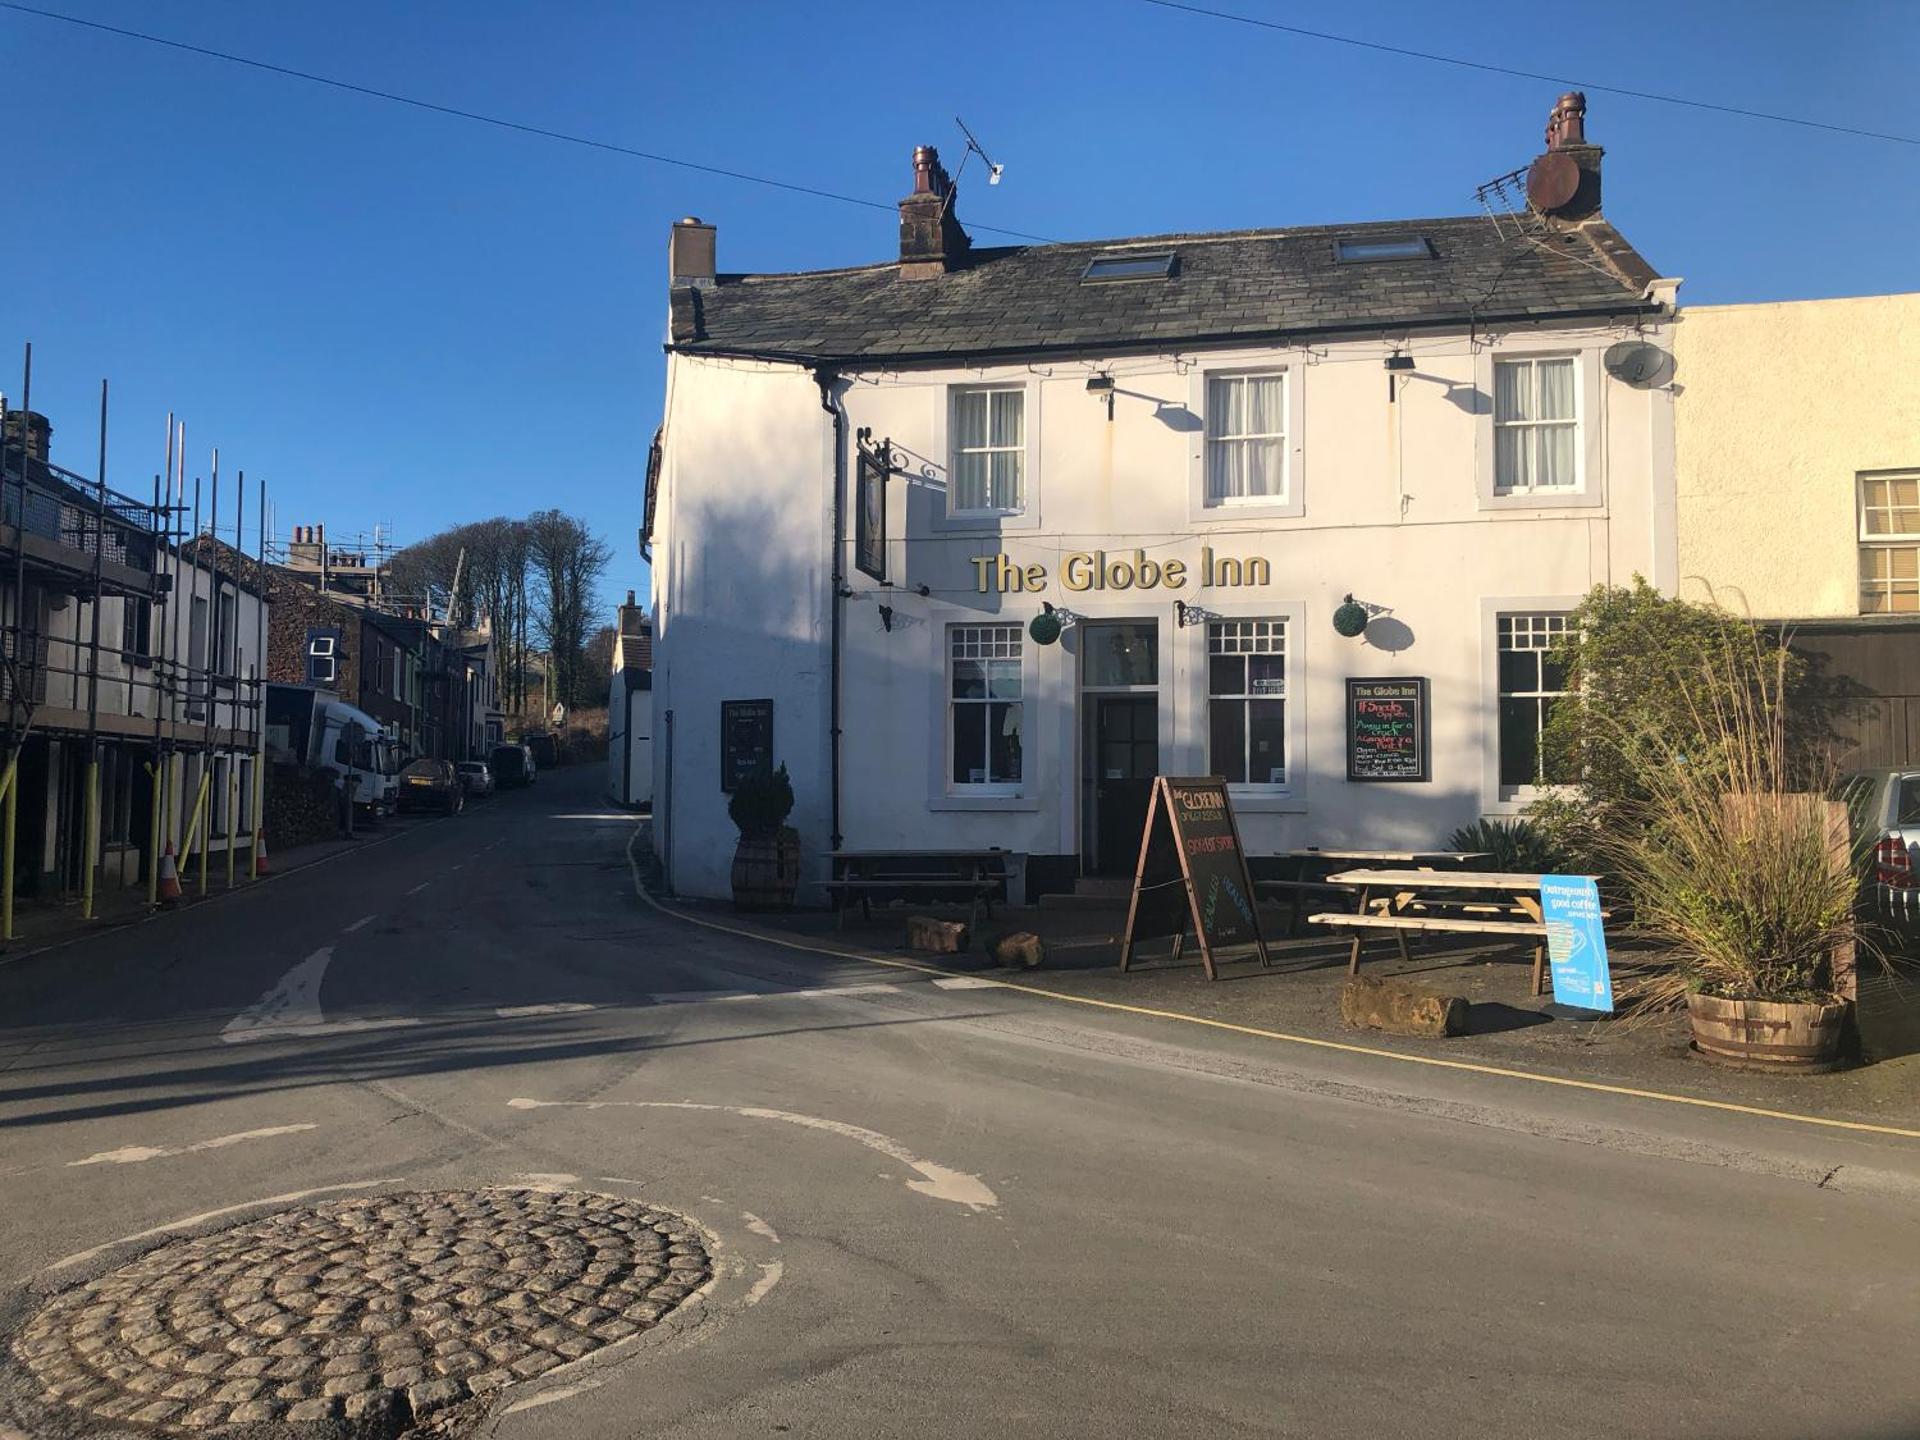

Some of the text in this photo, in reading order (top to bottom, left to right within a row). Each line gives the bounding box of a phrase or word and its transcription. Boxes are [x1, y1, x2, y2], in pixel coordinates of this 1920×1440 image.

[971, 546, 1271, 593] The Globe Inn
[1356, 686, 1416, 696] The Globe Inn
